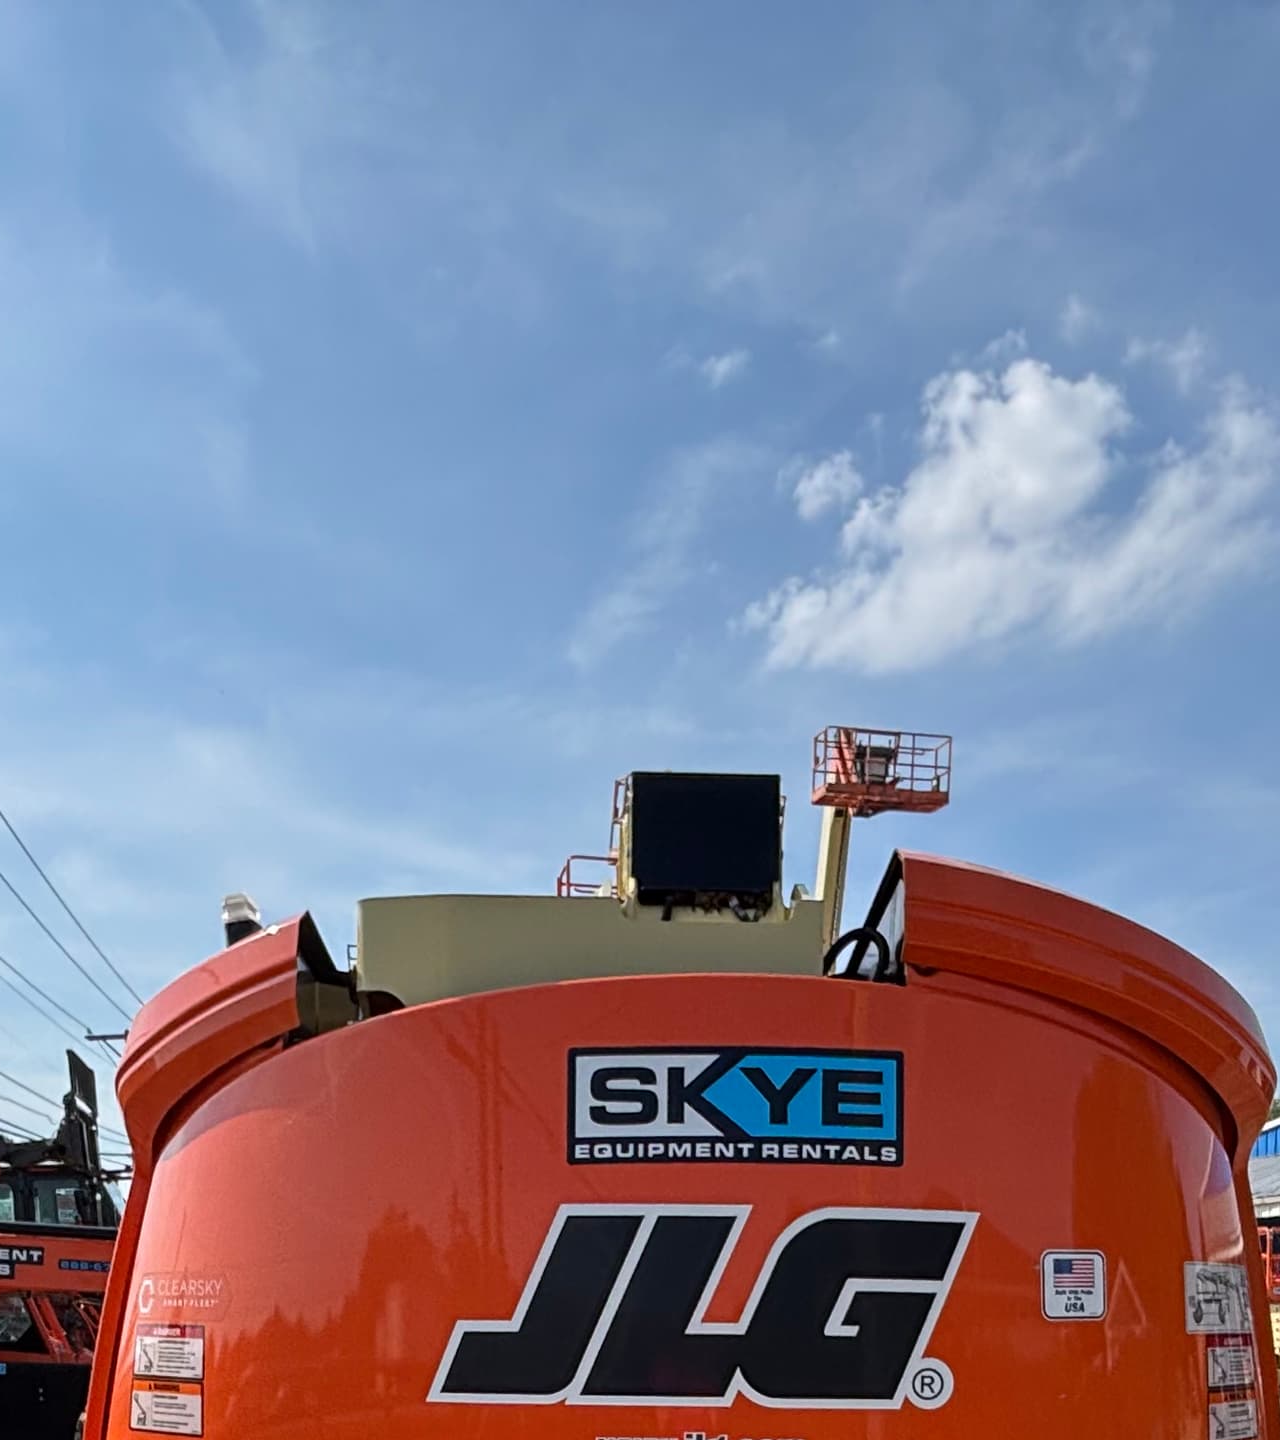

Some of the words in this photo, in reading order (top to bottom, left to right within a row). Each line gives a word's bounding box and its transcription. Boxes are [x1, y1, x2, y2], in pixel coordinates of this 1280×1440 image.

[589, 1063, 884, 1131] SKYE
[574, 1143, 754, 1159] EQUIPMENT
[762, 1144, 897, 1162] RENTALS
[157, 1279, 223, 1297] CLEARSKY
[1064, 1302, 1085, 1313] USA
